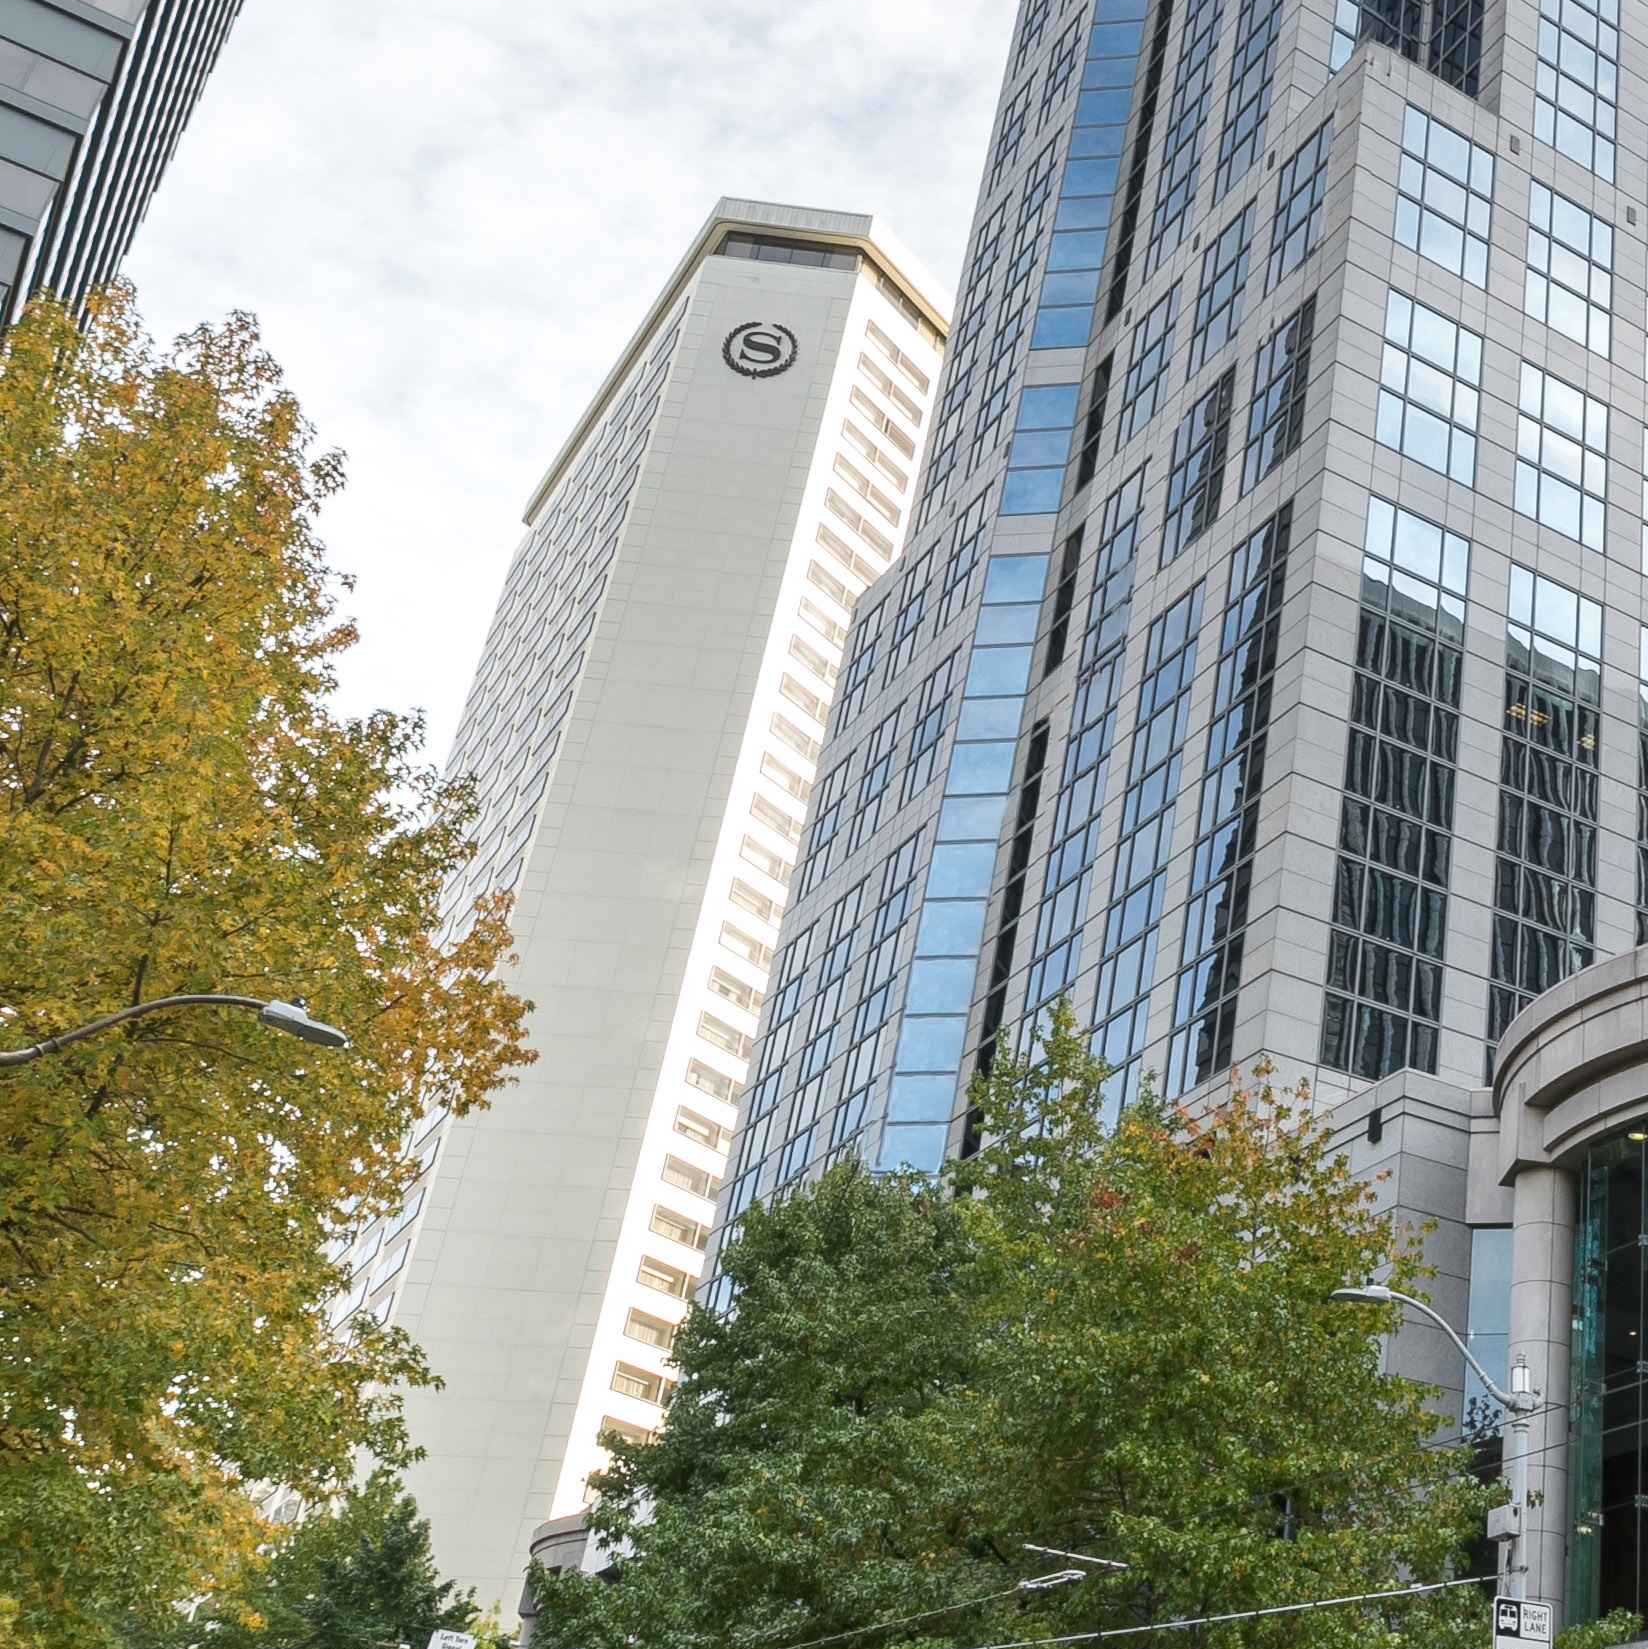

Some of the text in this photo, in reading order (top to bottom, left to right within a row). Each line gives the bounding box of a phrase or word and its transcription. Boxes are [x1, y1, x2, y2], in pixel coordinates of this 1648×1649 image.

[740, 331, 782, 365] S
[1522, 1607, 1547, 1622] RIGHT
[1524, 1621, 1546, 1634] LANE
[440, 1633, 454, 1641] Left
